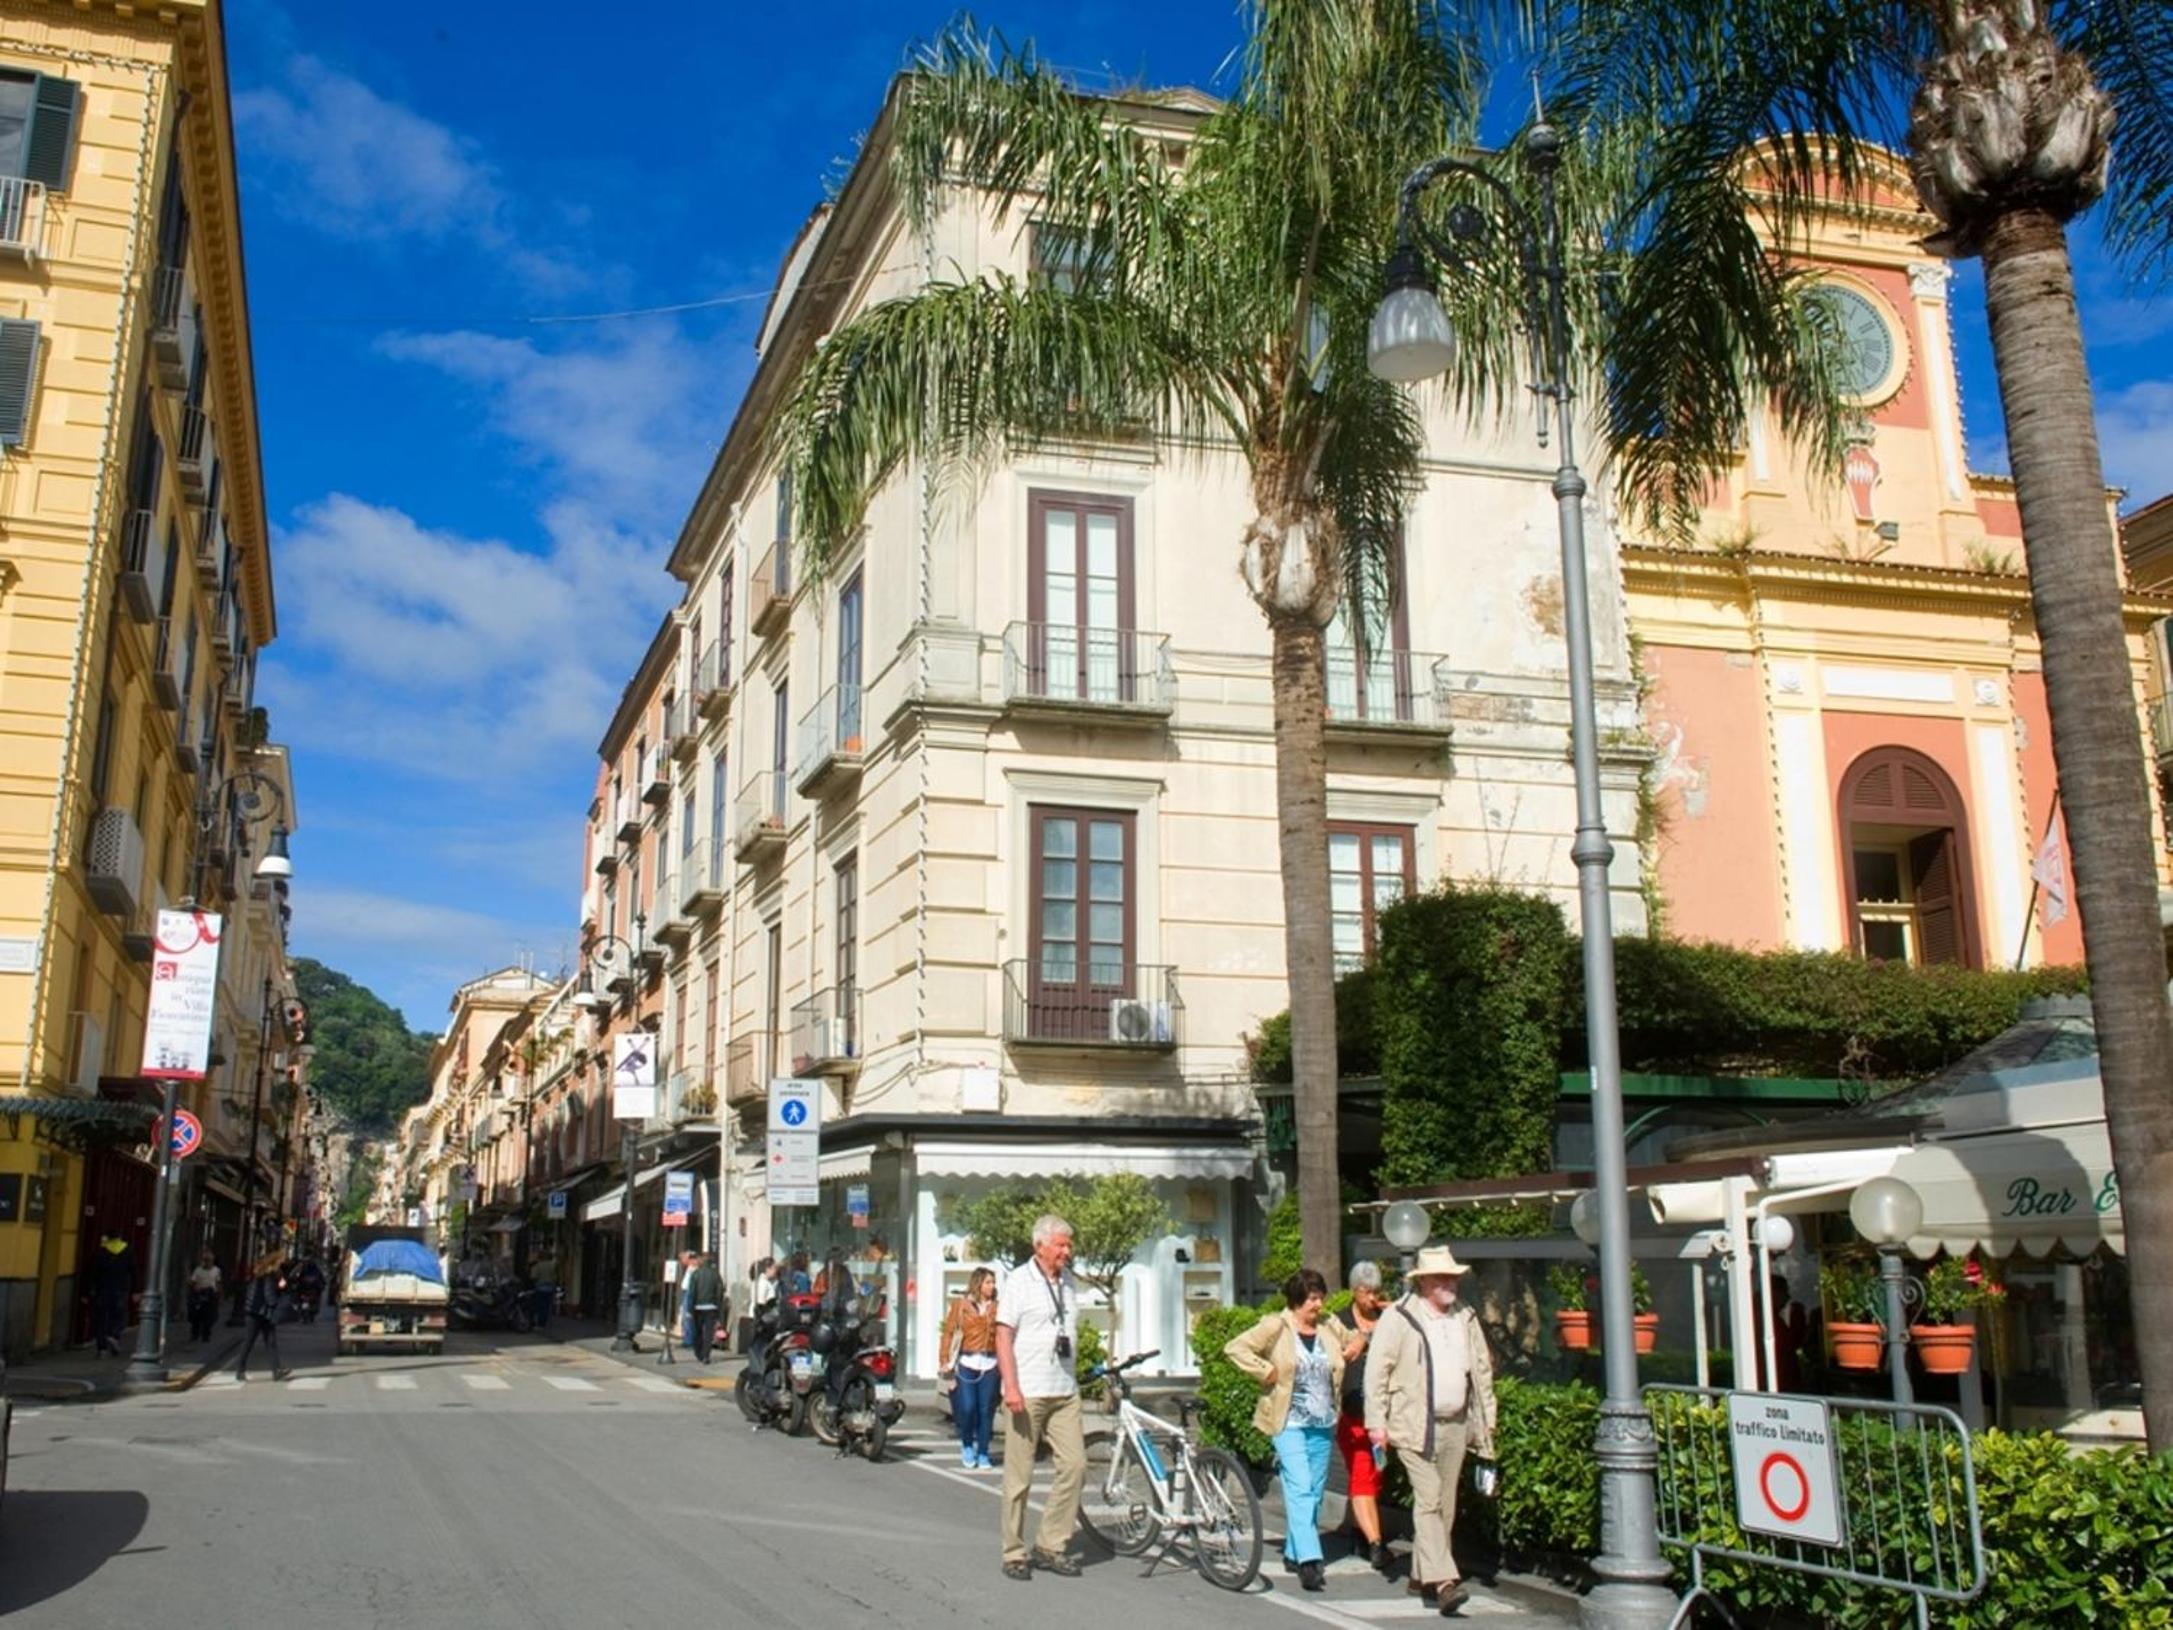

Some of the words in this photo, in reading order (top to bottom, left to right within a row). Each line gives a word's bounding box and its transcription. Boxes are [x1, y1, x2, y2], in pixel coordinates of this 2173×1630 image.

[2002, 1177, 2078, 1217] Bar
[1765, 1407, 1789, 1420] zona
[1736, 1421, 1777, 1438] traffico
[1781, 1425, 1825, 1445] limitato
